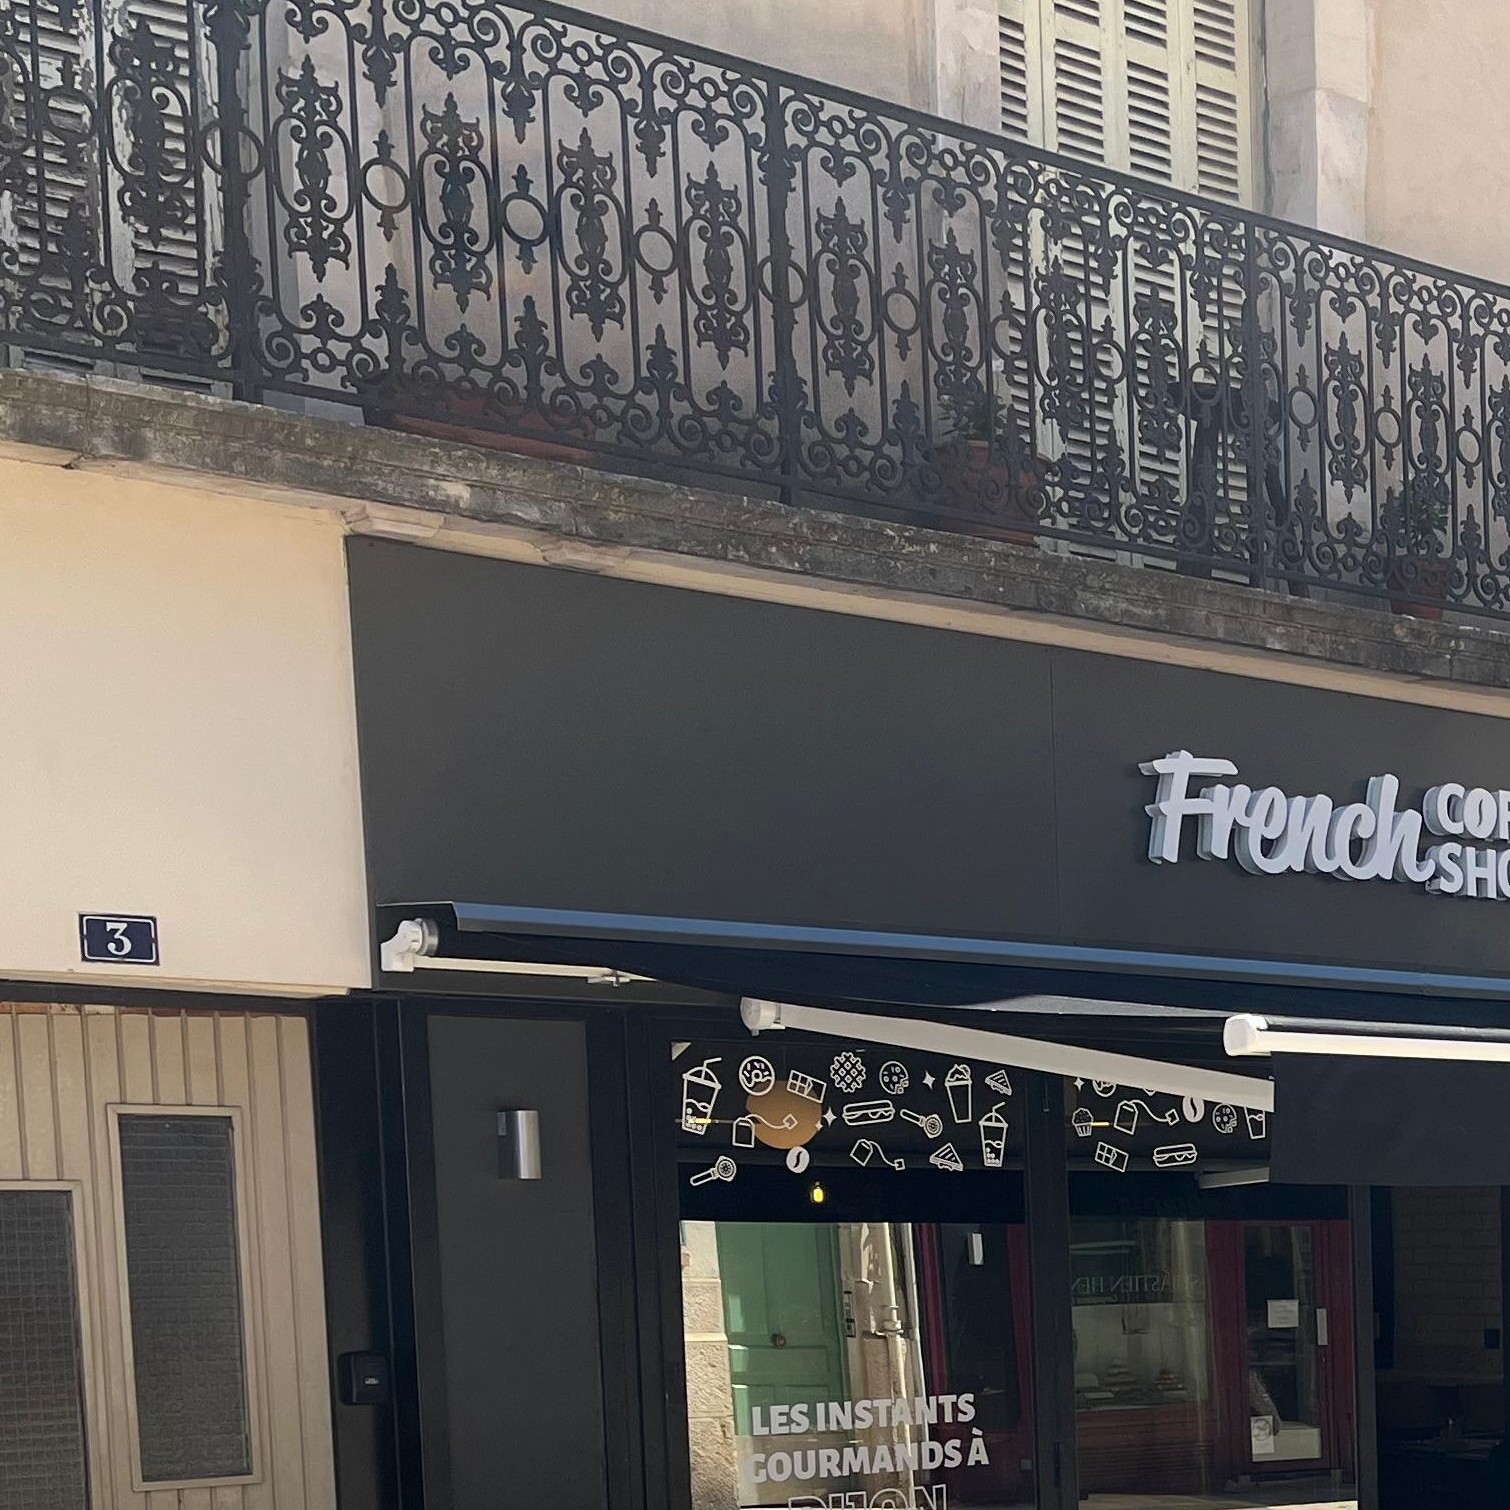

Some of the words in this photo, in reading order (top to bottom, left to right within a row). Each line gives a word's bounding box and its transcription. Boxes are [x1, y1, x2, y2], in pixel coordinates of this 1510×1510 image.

[1138, 750, 1435, 883] French
[106, 922, 132, 955] 3
[752, 1404, 810, 1436] LES
[816, 1393, 976, 1432] INSTANTS
[745, 1438, 962, 1483] GOURMANDS
[967, 1427, 989, 1467] À
